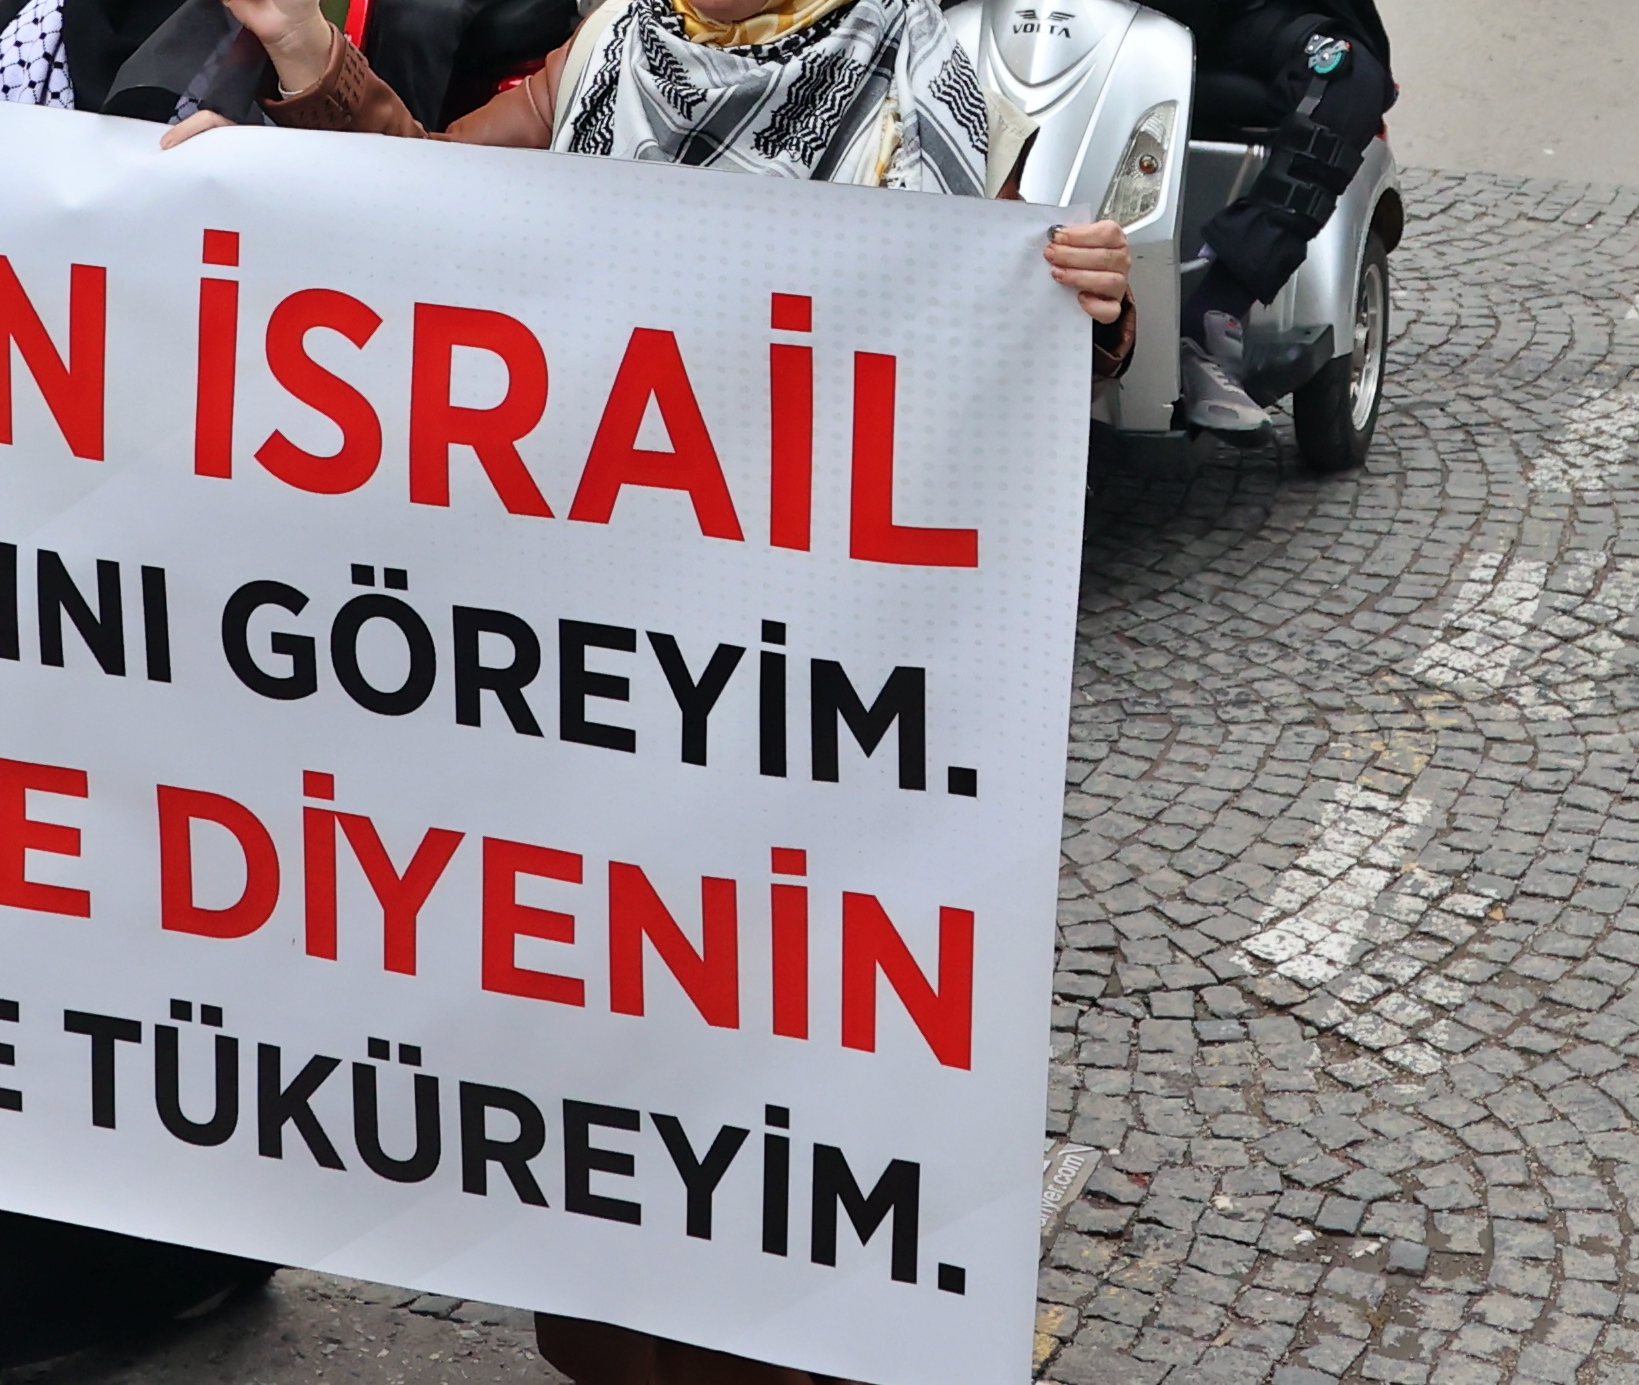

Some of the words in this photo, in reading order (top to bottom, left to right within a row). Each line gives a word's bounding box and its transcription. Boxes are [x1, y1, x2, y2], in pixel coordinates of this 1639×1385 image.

[1012, 22, 1072, 39] VOLTA
[194, 227, 980, 569] İSRAİL
[220, 562, 979, 798] GÖREYİM.
[156, 769, 976, 1072] DİYENİN
[63, 998, 967, 1296] TÜKÜREYİM.
